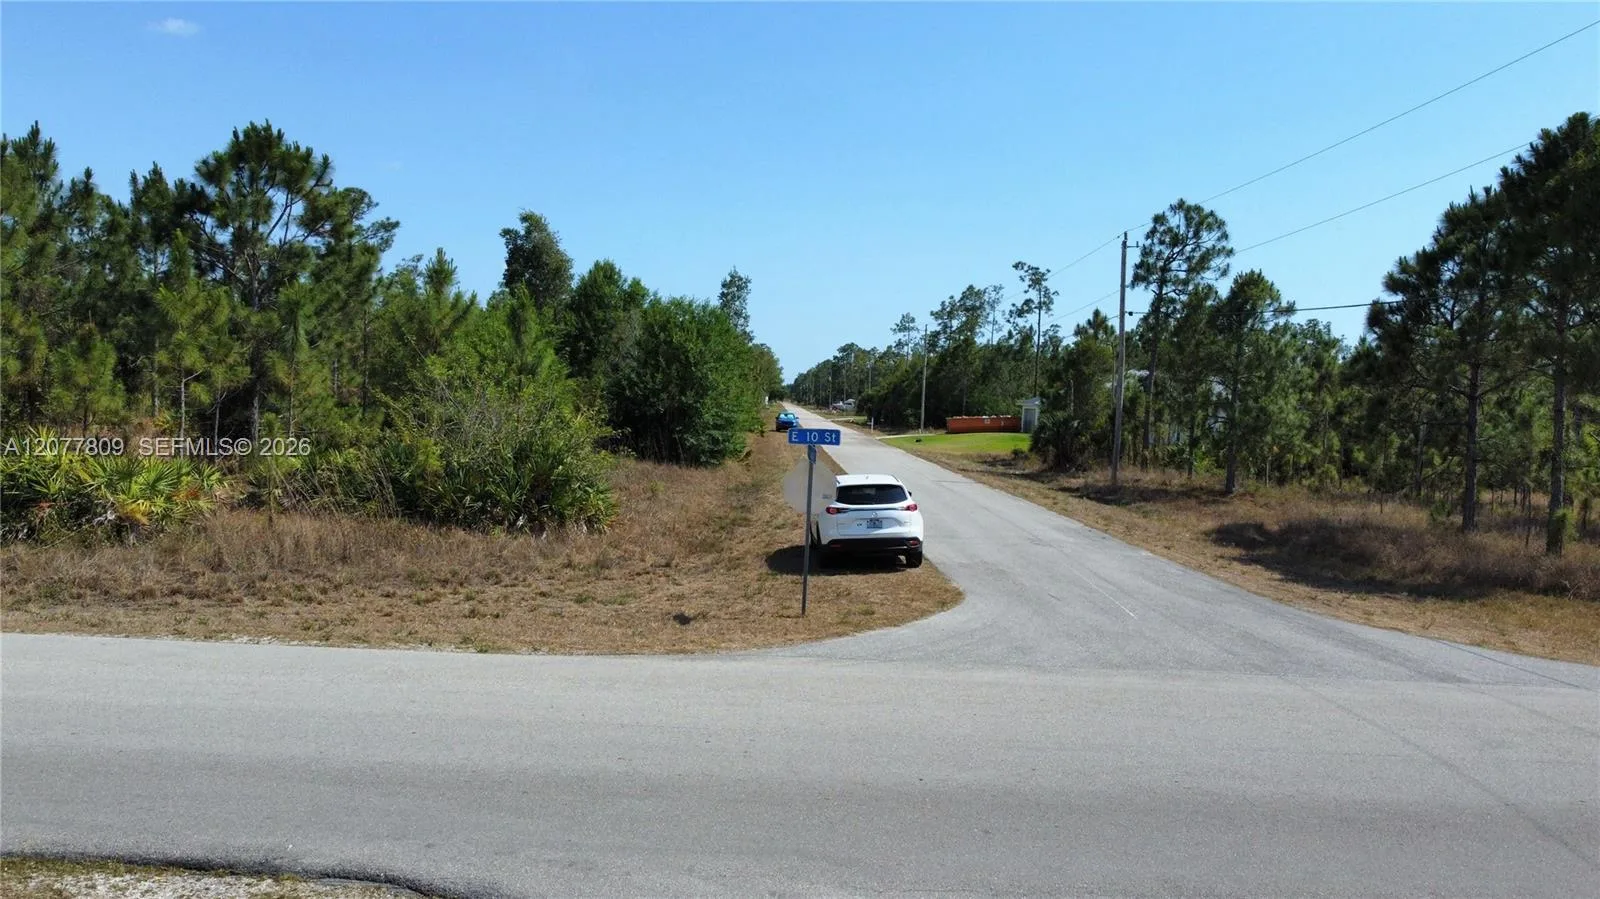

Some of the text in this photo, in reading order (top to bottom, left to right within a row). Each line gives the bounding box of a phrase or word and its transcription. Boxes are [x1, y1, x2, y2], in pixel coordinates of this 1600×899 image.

[791, 431, 836, 443] E 10 St
